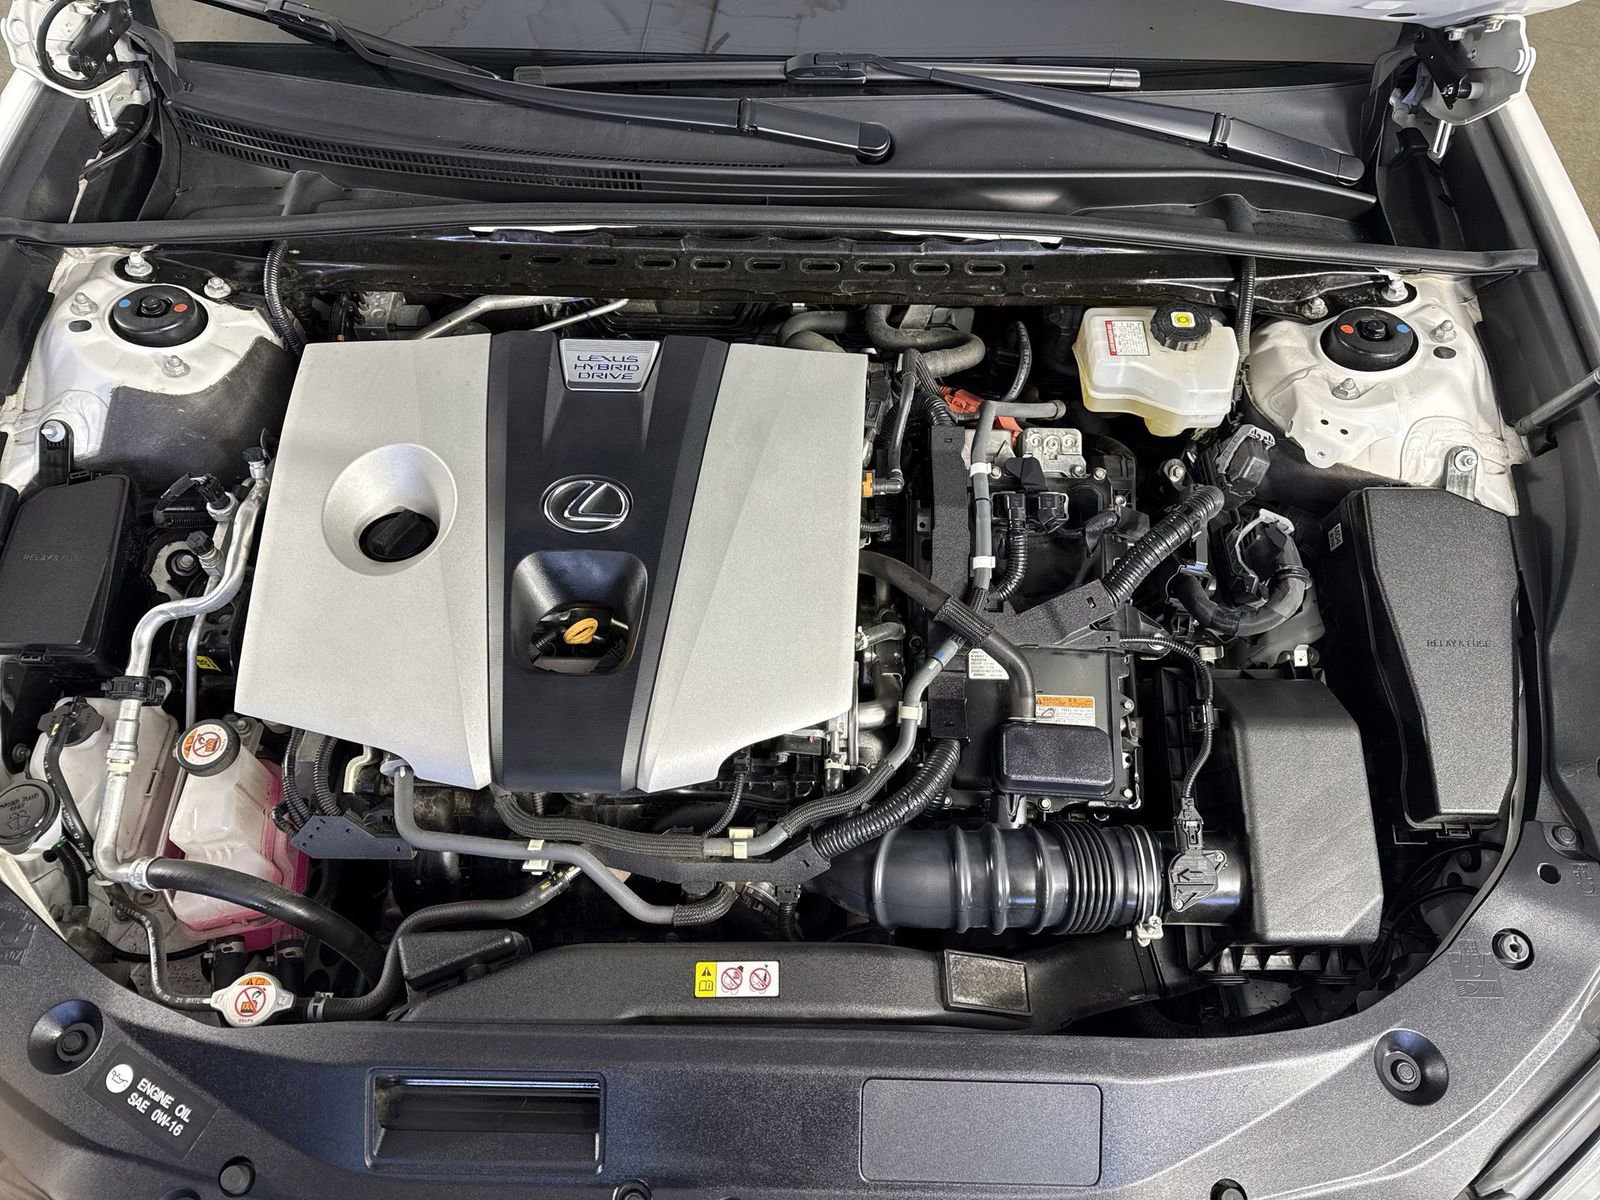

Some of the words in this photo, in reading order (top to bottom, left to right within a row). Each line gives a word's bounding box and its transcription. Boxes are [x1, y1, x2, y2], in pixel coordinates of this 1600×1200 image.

[577, 354, 639, 363] LEXUS
[573, 363, 640, 372] HYBRID
[578, 372, 634, 380] DRIVE
[22, 553, 53, 561] RELAY
[1426, 639, 1457, 648] RELAY
[1466, 639, 1492, 649] FUSE
[137, 1078, 175, 1109] ENGINE
[174, 1104, 192, 1123] OIL
[127, 1092, 151, 1114] SAE
[150, 1109, 184, 1137] 0W-16
